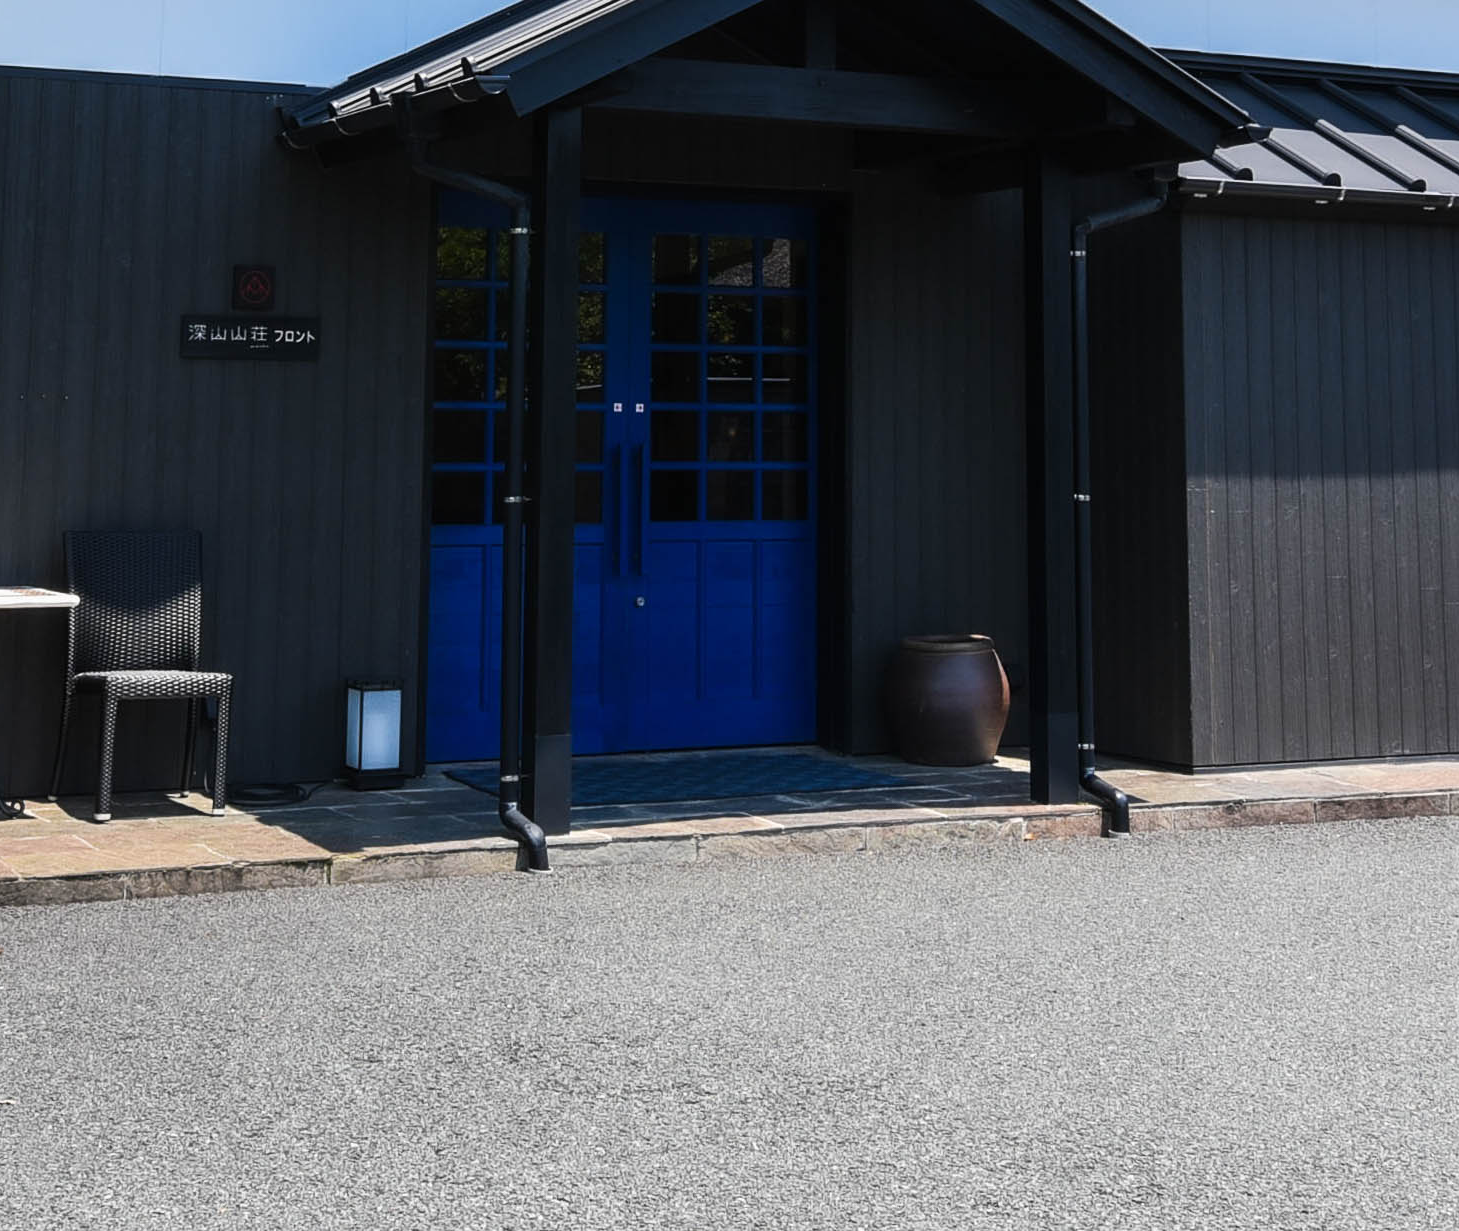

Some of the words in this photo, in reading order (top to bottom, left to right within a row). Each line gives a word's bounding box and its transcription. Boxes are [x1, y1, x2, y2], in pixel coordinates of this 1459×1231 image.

[188, 324, 268, 341] 深山山荘
[274, 329, 316, 343] フロント
